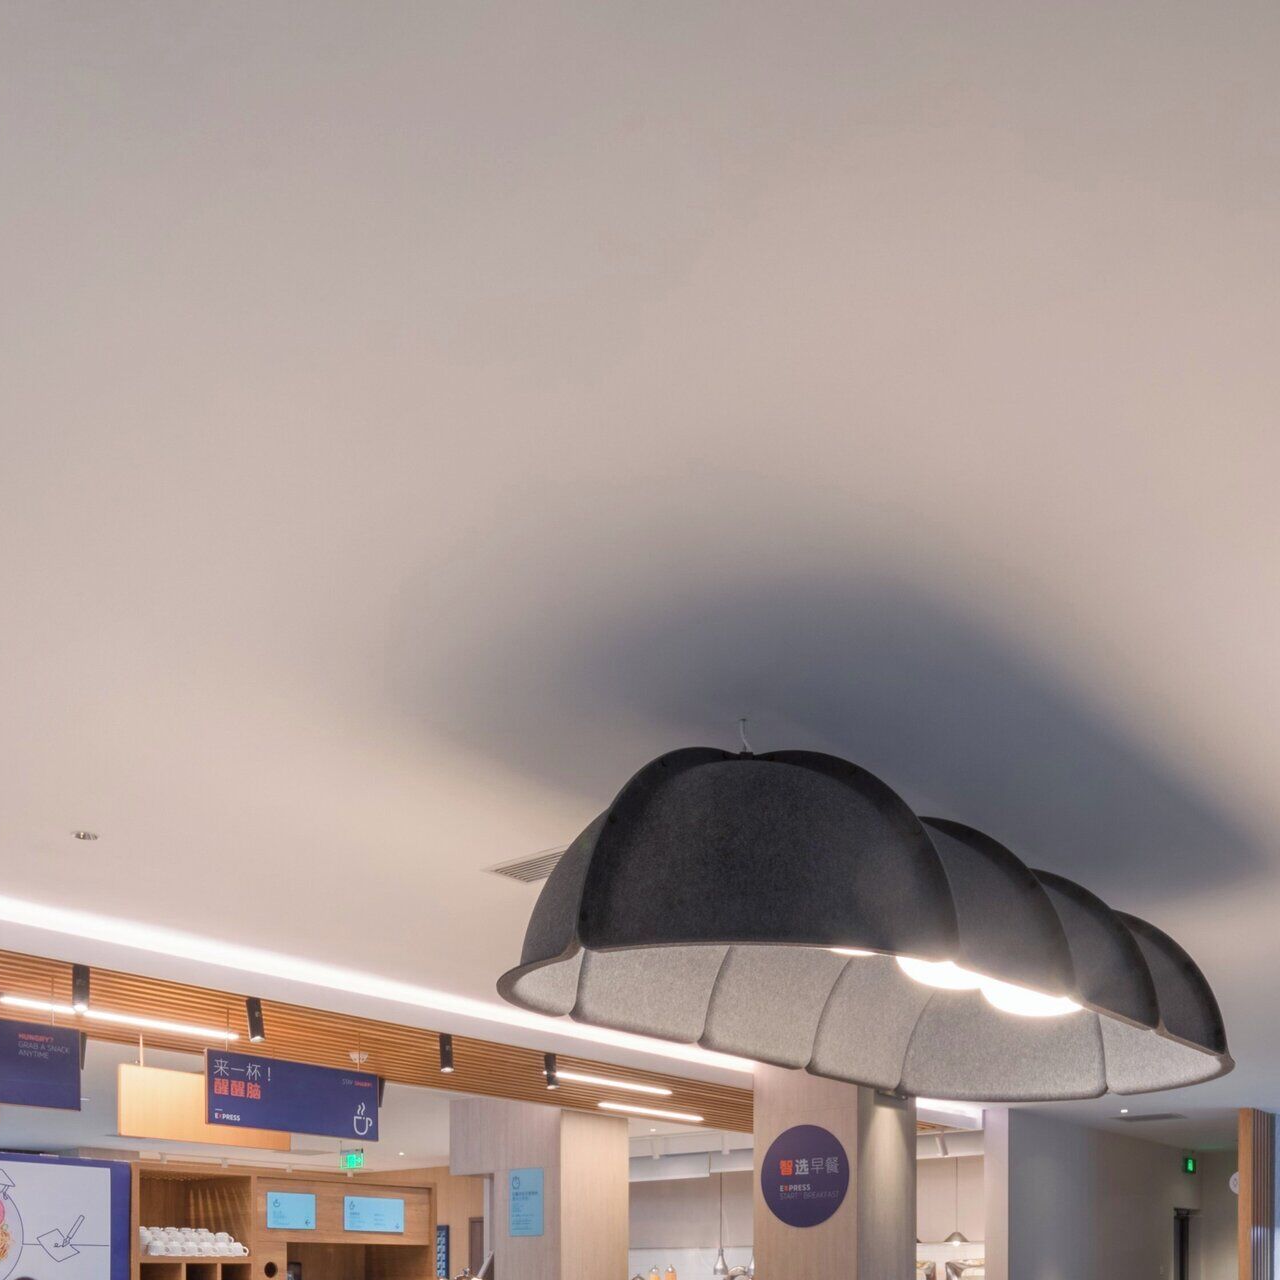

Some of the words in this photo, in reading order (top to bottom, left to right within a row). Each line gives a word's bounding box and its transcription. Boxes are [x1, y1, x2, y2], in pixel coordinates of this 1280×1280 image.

[18, 1033, 54, 1043] HUNGRY?
[18, 1041, 38, 1050] GRAB
[47, 1044, 69, 1054] SNACK
[18, 1050, 49, 1059] ANYTIME
[214, 1078, 261, 1100] 醒醒脑
[215, 1113, 240, 1121] EXPRESS
[780, 1157, 840, 1176] 智选早餐
[780, 1184, 811, 1192] EXPRESS
